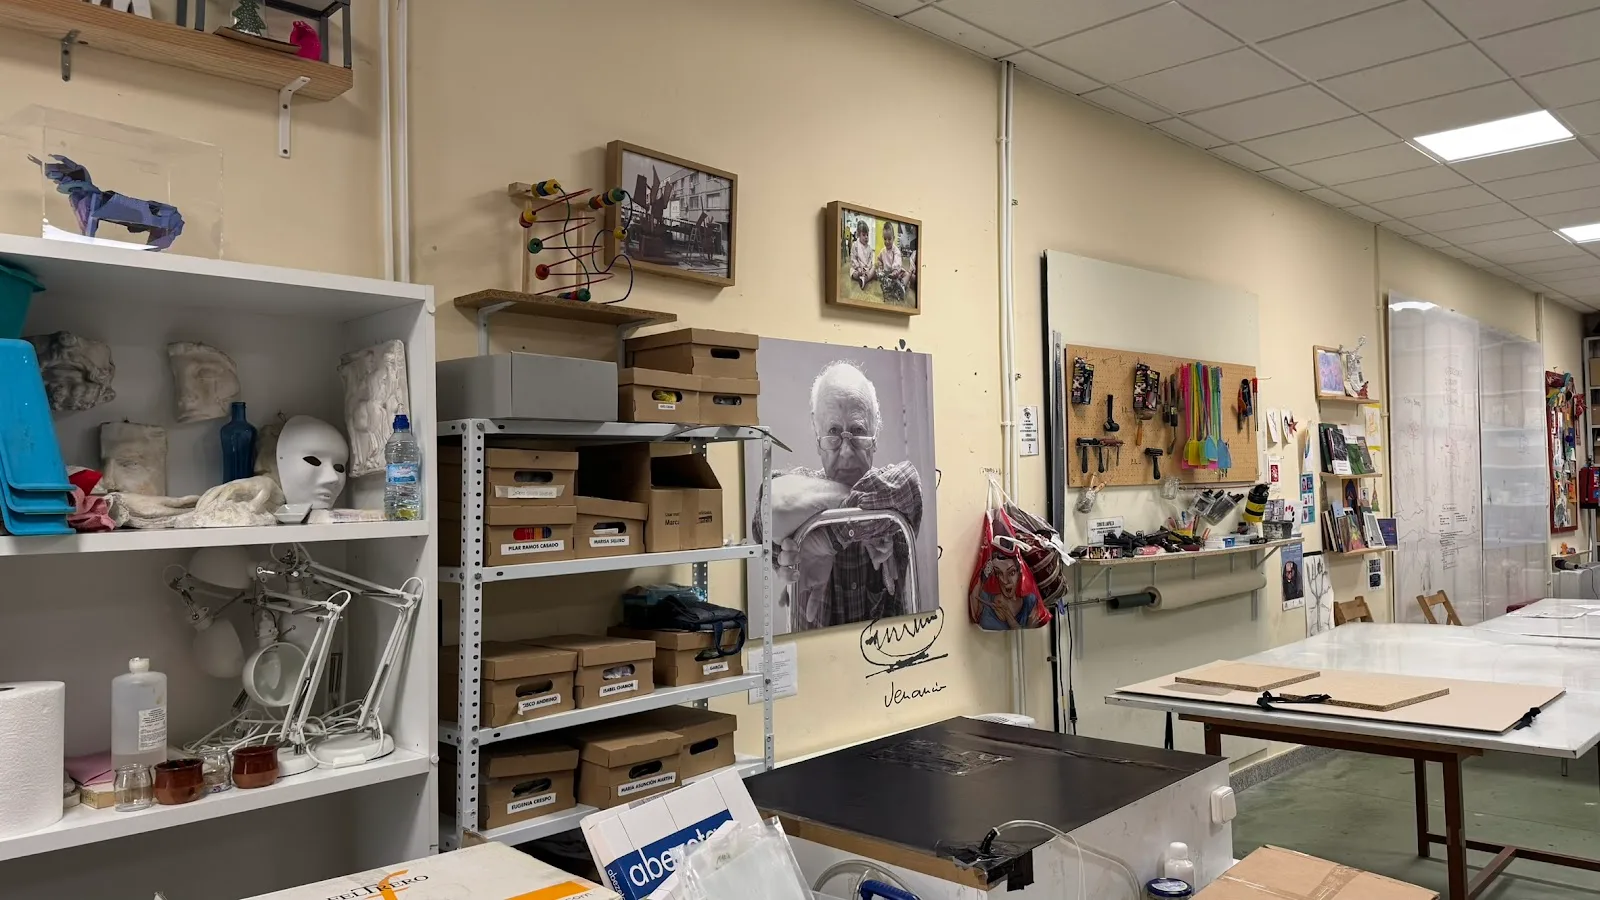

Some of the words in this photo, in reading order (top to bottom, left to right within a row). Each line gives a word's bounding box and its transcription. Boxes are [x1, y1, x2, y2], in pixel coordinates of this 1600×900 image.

[602, 686, 616, 694] ISABEL
[635, 779, 657, 789] ASUNCIÓN
[511, 800, 533, 810] EUGENIA
[533, 795, 552, 805] CRESPO
